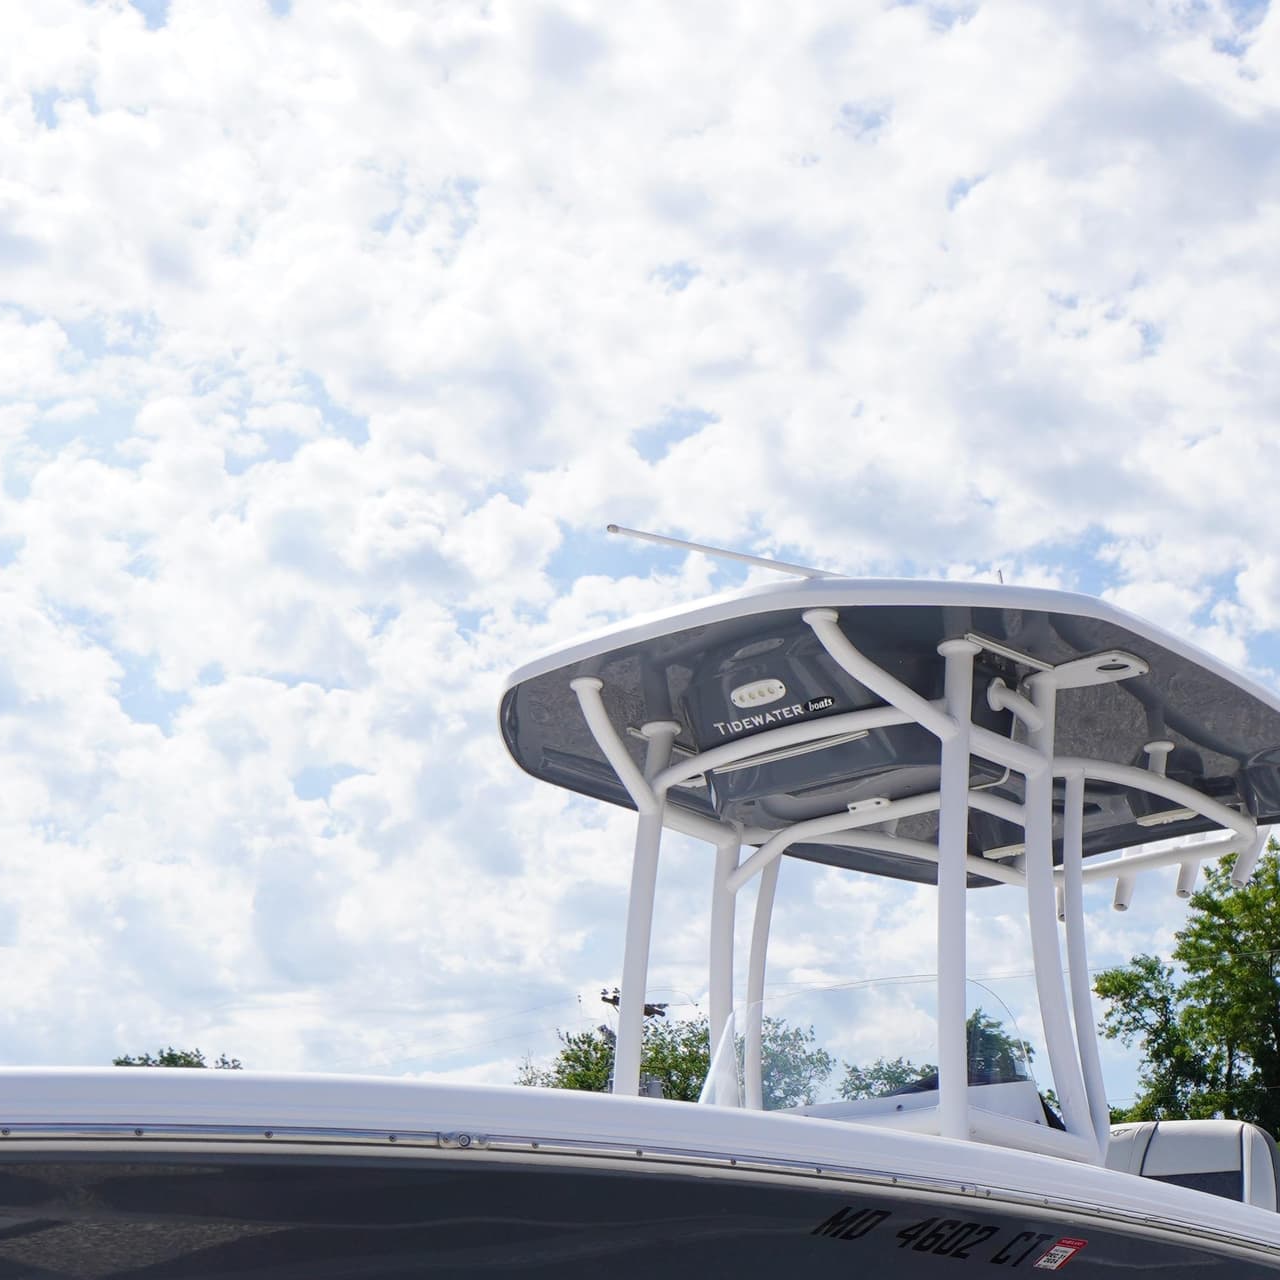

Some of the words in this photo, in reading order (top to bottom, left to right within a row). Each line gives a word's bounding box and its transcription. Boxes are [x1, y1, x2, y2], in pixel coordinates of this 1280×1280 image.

[713, 703, 805, 735] TIDEWATER
[808, 697, 834, 711] boats
[810, 1206, 892, 1240] MD
[896, 1217, 1000, 1259] 4602
[990, 1232, 1055, 1267] CT
